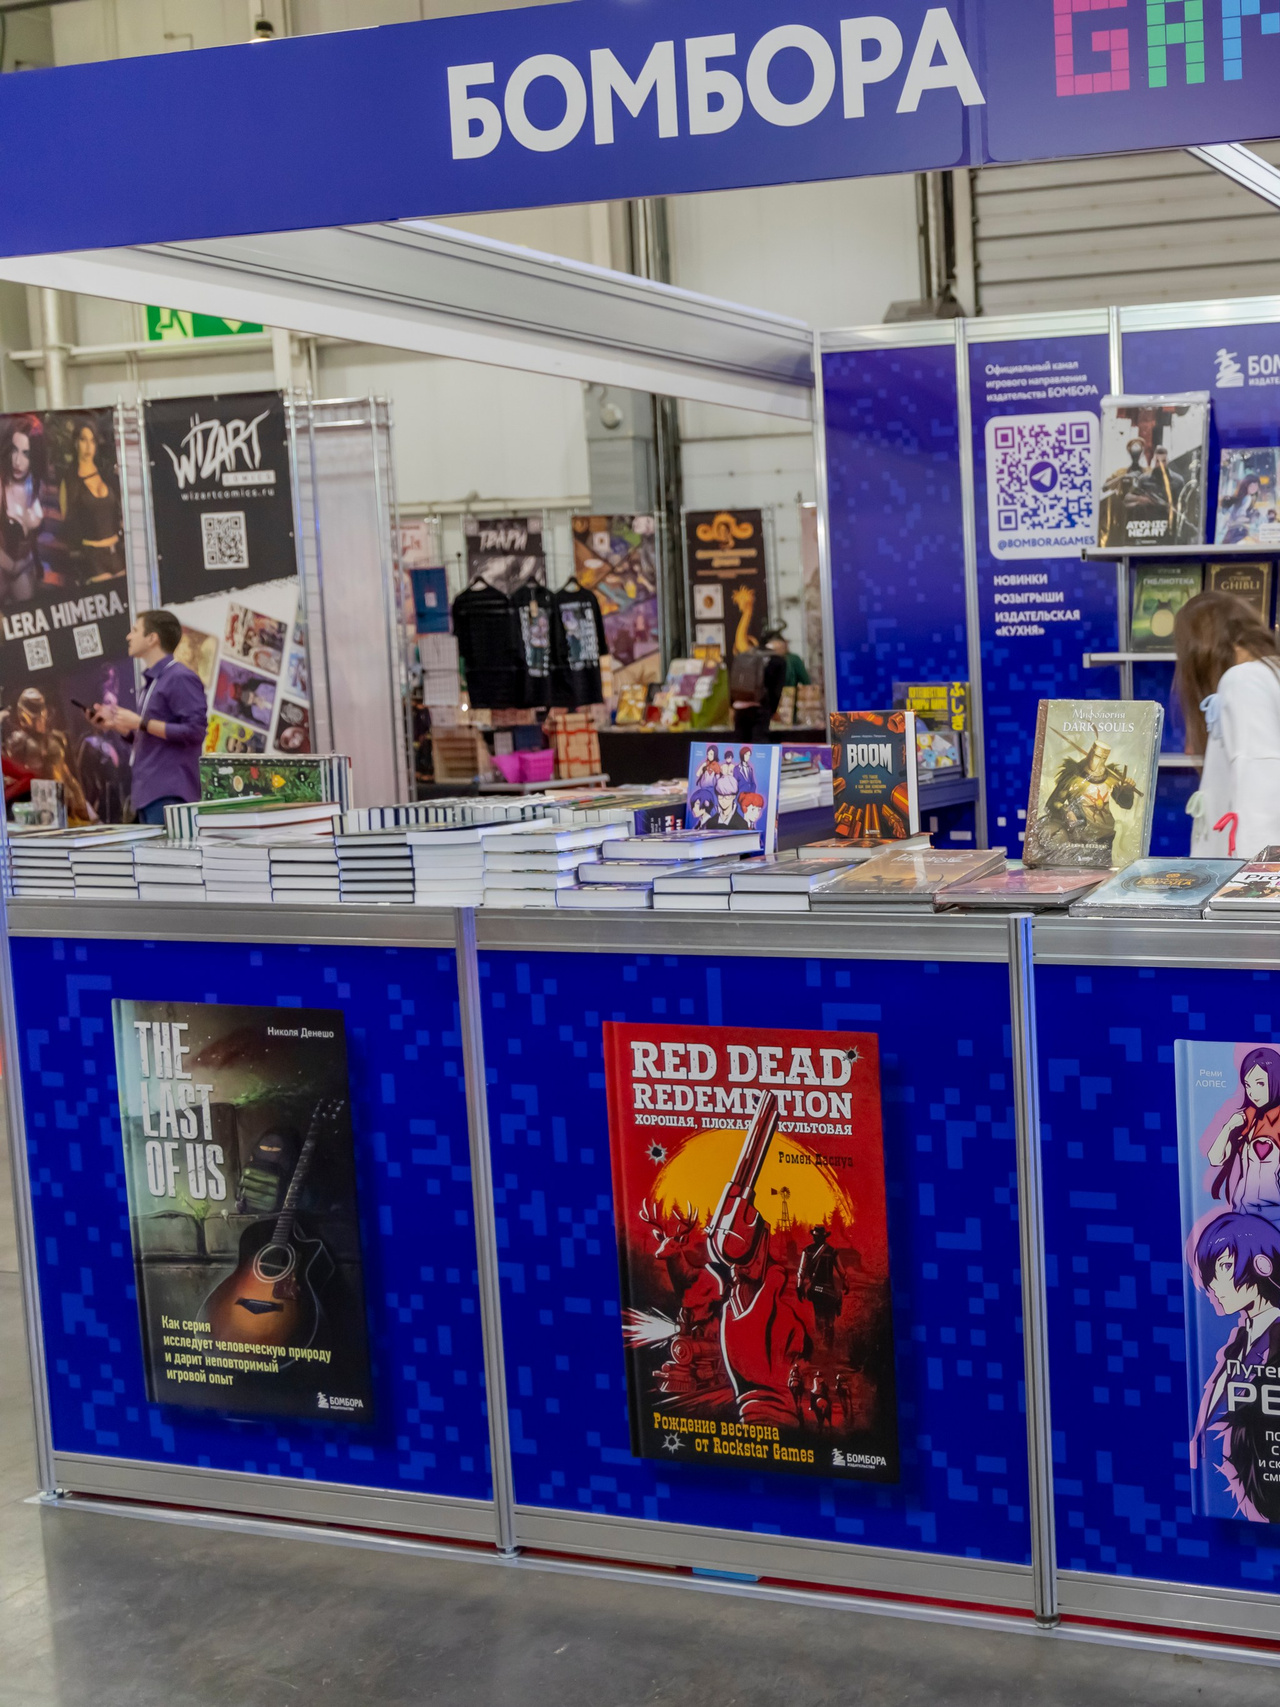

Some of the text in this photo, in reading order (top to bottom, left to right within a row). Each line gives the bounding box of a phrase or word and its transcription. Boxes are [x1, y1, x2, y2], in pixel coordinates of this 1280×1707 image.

[447, 7, 986, 160] БОМБОРА
[985, 361, 1079, 376] Официальный канал
[985, 373, 1087, 389] игрового направления
[986, 385, 1099, 402] издательства БОМБОРА
[161, 408, 271, 489] WIZART
[181, 487, 275, 501] wizartcomics.ru
[1127, 529, 1167, 538] HEART
[997, 536, 1096, 550] @BOMBORAGAMES
[994, 574, 1048, 586] НОВИНКИ
[1143, 578, 1195, 586] ГИБЛИОТЕКА
[1220, 581, 1260, 591] GHIBLI
[994, 592, 1064, 604] РОЗЫГРЫШИ
[2, 590, 125, 641] LERA HIMERA
[995, 609, 1081, 624] ИЗДАТЕЛЬСКАЯ
[995, 625, 1046, 638] «КУХНЯ»
[1072, 708, 1126, 722] Мифология
[1062, 721, 1135, 733] DARK SOULS
[846, 743, 893, 775] BOOM
[267, 1027, 335, 1039] Николя Денешо
[134, 1021, 192, 1080] THE
[630, 1041, 853, 1087] RED DEAD
[1199, 1068, 1223, 1078] Реми
[1195, 1079, 1227, 1089] ЛОПЕС
[140, 1082, 213, 1141] LAST
[634, 1114, 853, 1136] ХОРОШАЯ, ПЛОХАЯ КУЛЬТОВАЯ
[778, 1151, 812, 1165] Ромен
[145, 1140, 227, 1201] OF US
[161, 1315, 212, 1334] Как серия
[163, 1335, 332, 1364] исследует человеческую природу
[165, 1353, 279, 1374] и дарит неповторимый
[166, 1370, 234, 1386] игровой опыт
[329, 1396, 364, 1408] БОМБОРА
[653, 1411, 780, 1442] Рождение вестерна
[695, 1436, 815, 1464] от Rockstar Games
[846, 1453, 887, 1466] БОМБОРА
[1258, 1459, 1266, 1468] и
